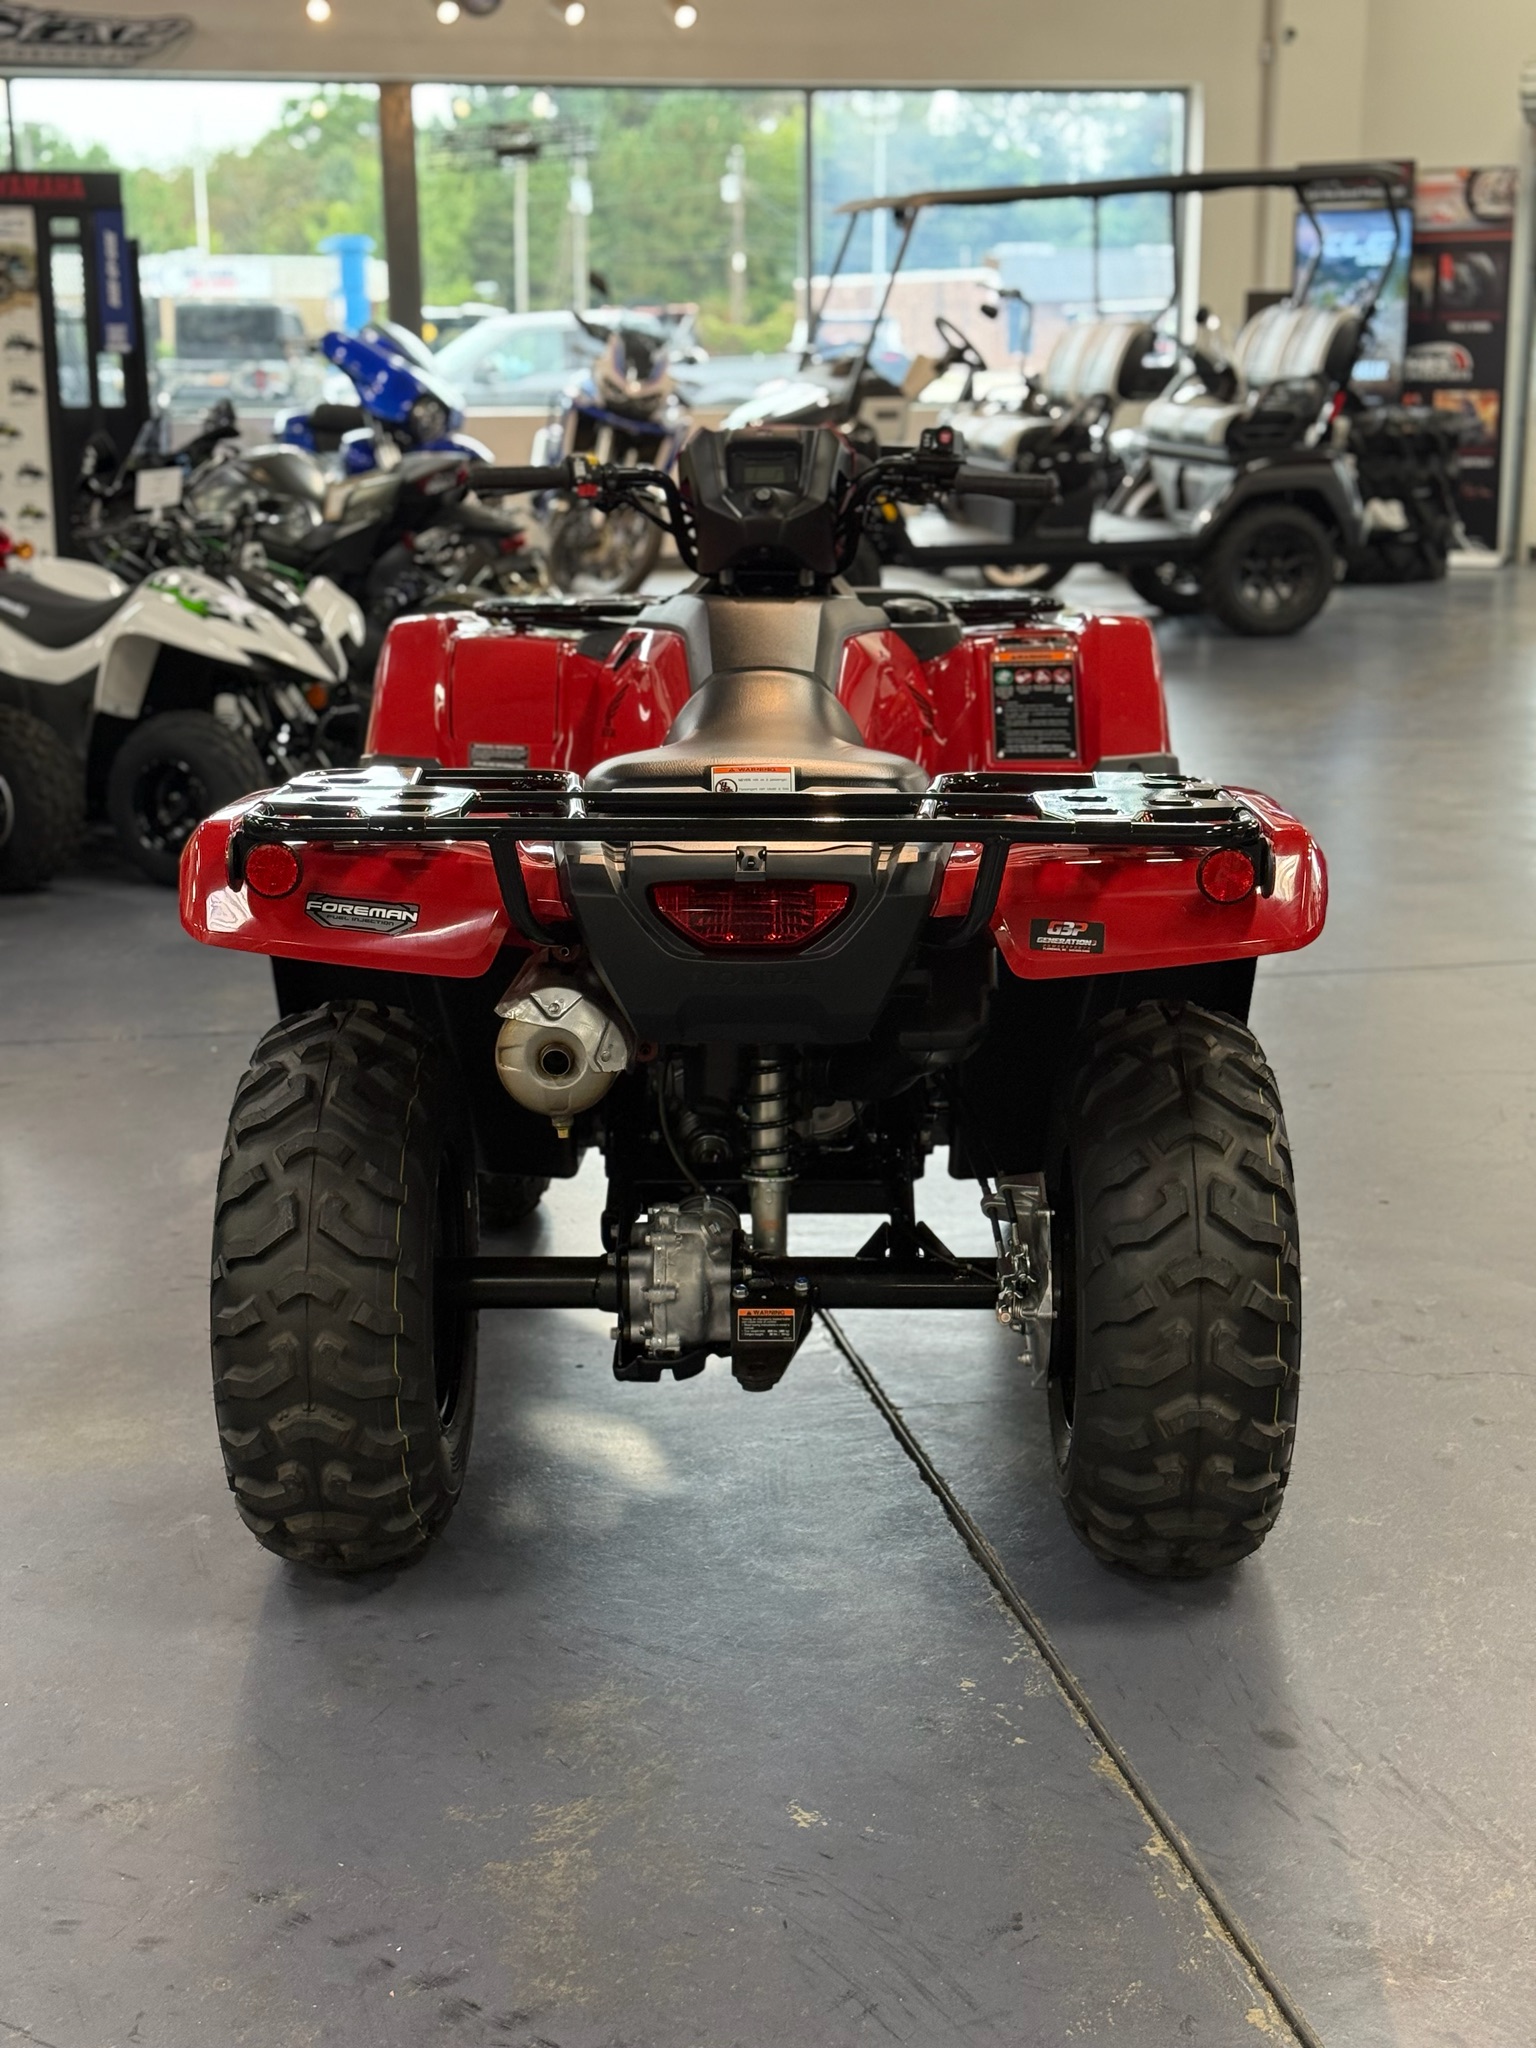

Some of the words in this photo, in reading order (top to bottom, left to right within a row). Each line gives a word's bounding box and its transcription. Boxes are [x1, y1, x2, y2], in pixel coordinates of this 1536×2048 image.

[306, 901, 418, 922] FOREMAN
[351, 916, 394, 926] INJECTION
[1046, 920, 1089, 937] G3P
[692, 969, 815, 985] ONDA
